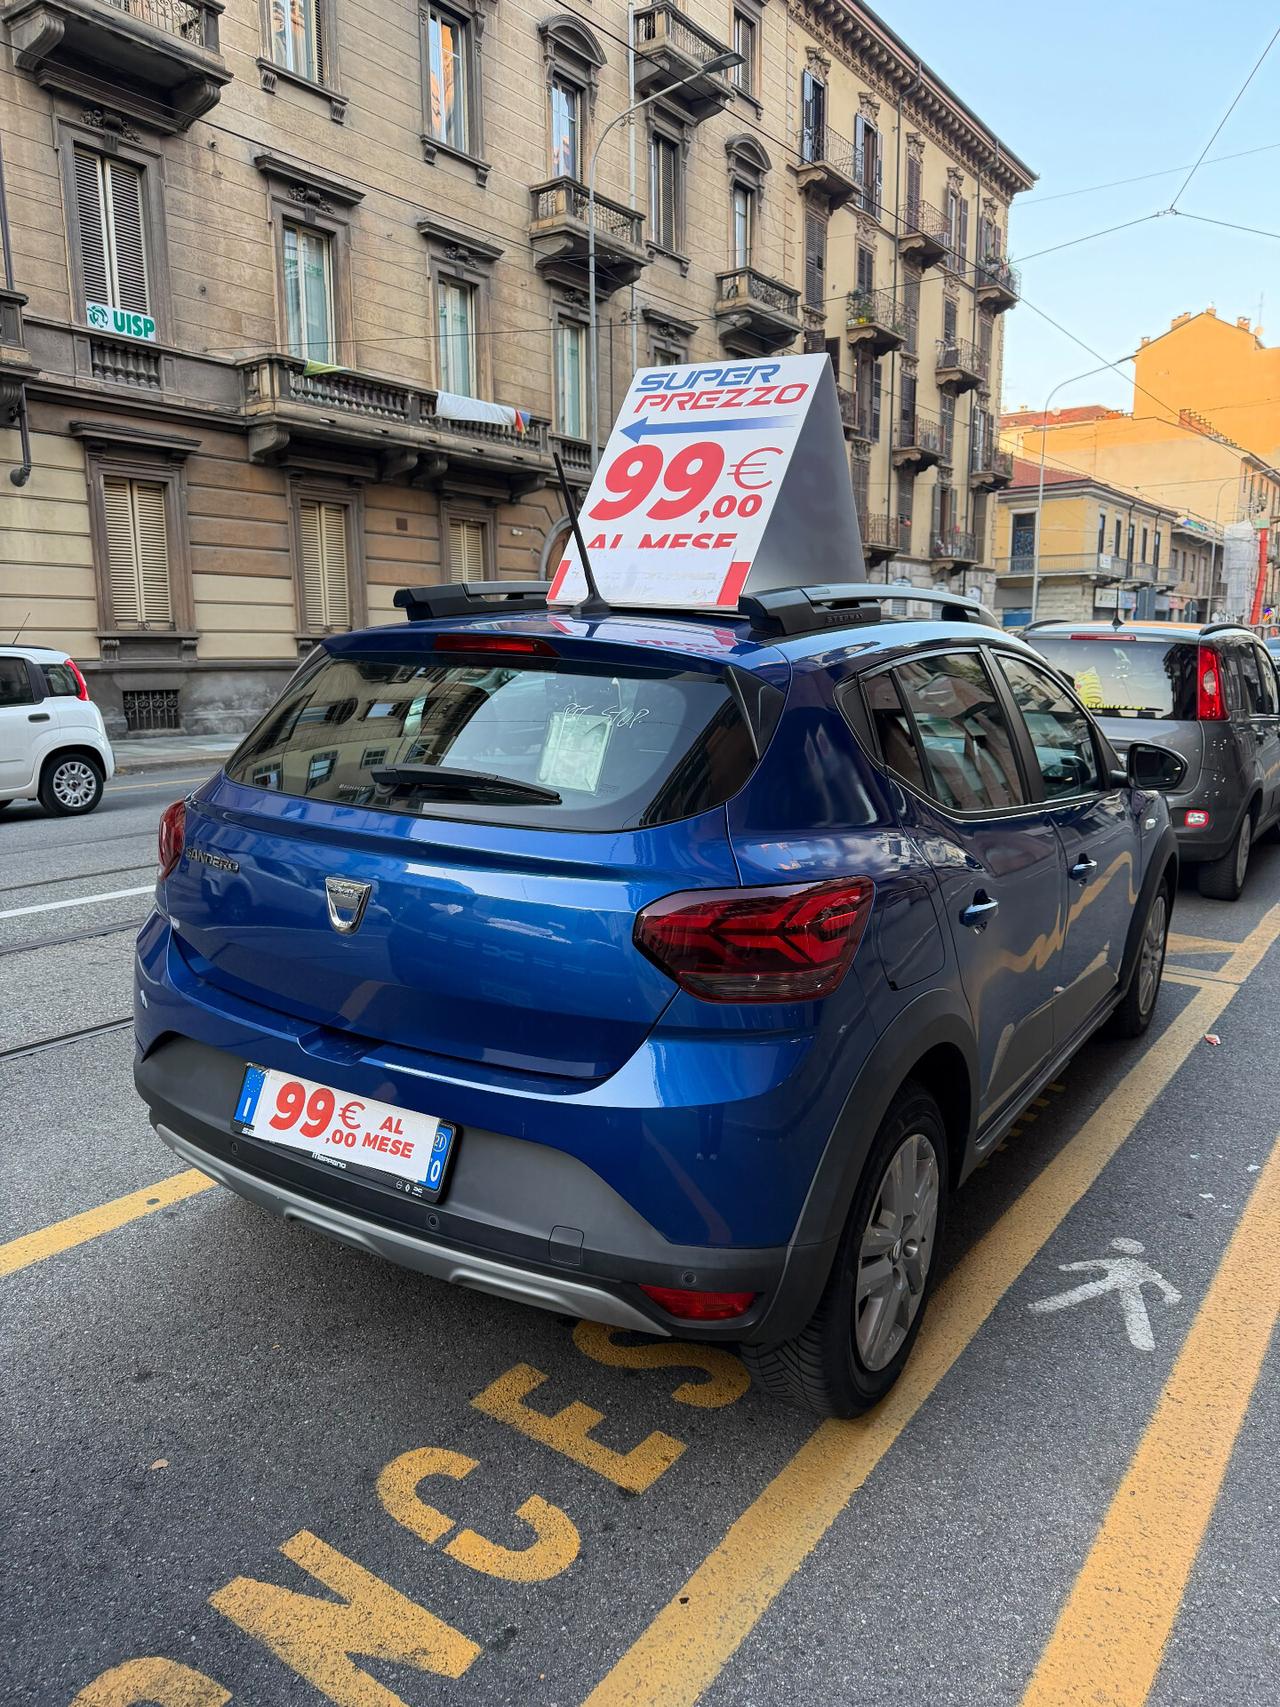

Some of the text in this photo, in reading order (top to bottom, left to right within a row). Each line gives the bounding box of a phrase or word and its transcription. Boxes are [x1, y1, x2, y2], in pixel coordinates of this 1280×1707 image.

[112, 310, 155, 338] UISP
[635, 363, 781, 393] SUPER
[633, 383, 810, 414] PREZZO
[185, 847, 240, 873] SANDERO
[379, 1115, 404, 1135] AL
[362, 1132, 415, 1159] MESE
